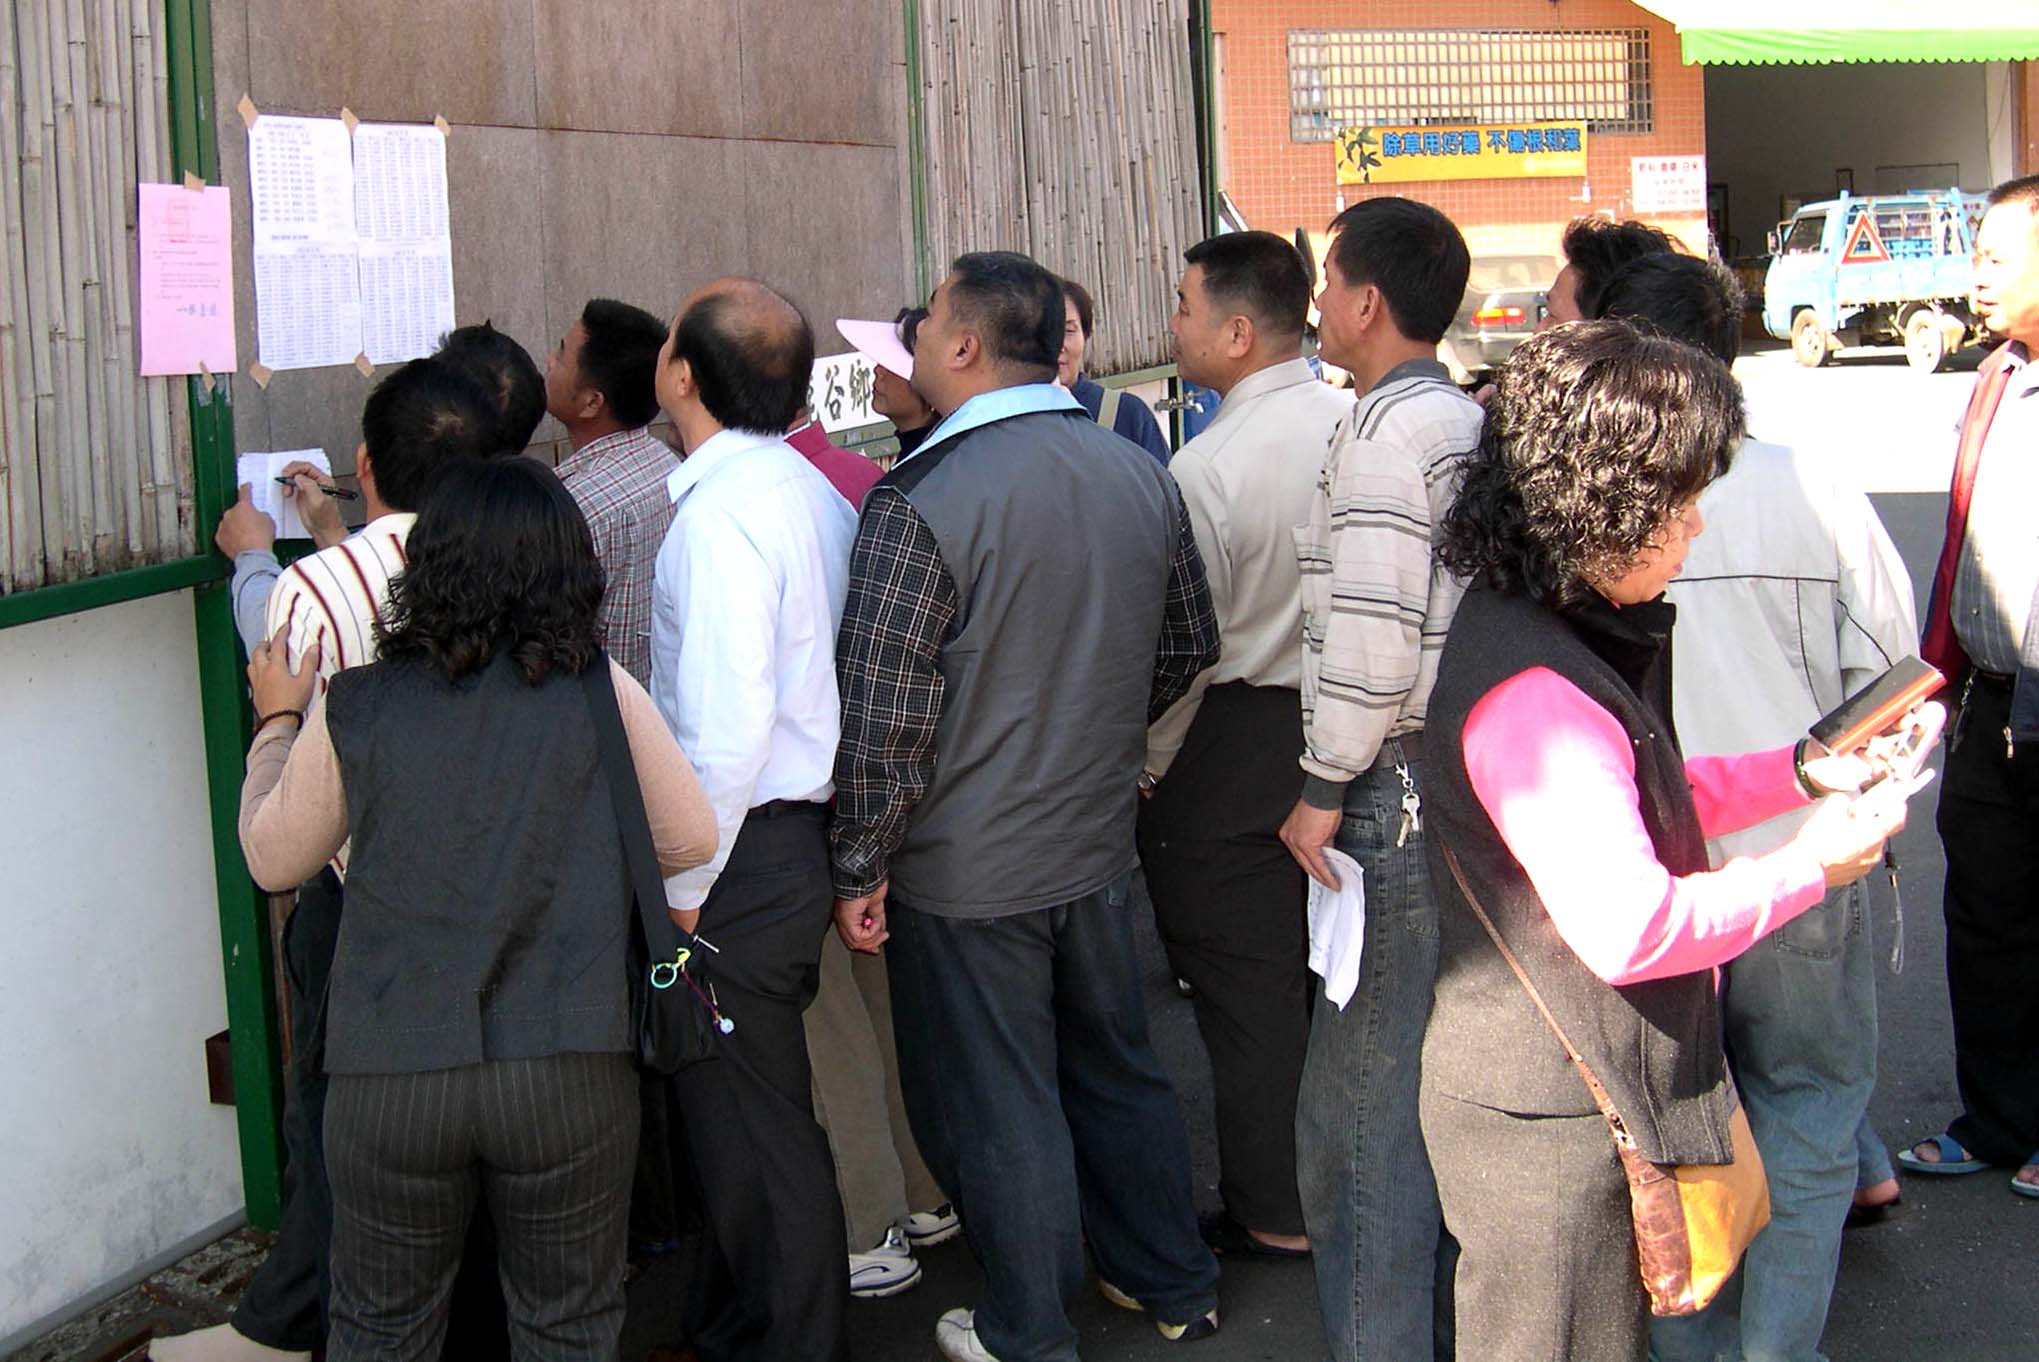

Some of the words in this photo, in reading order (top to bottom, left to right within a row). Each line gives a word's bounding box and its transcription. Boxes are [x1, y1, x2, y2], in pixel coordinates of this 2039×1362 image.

[1382, 129, 1480, 157] 除草用好藥
